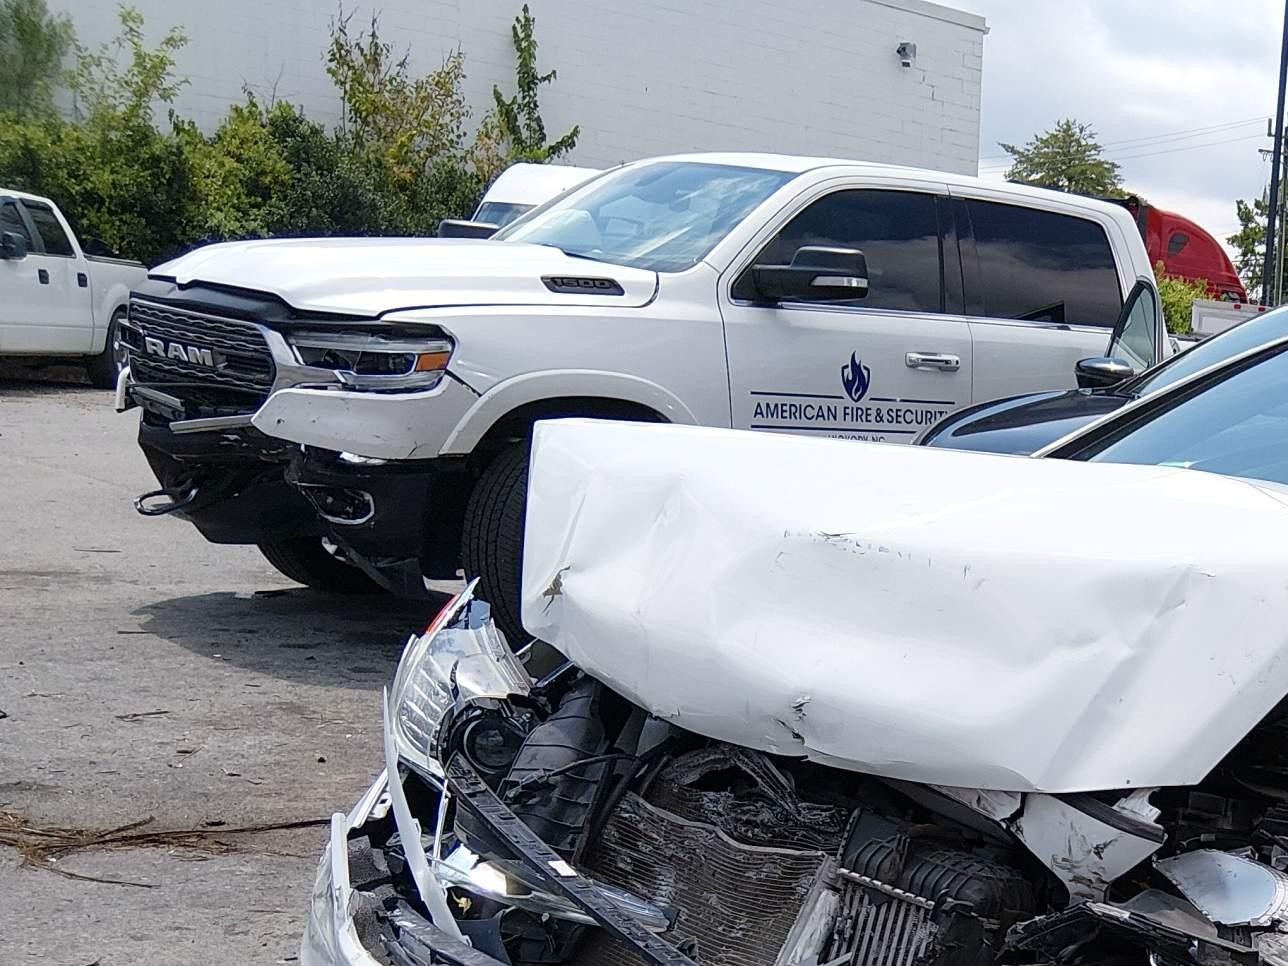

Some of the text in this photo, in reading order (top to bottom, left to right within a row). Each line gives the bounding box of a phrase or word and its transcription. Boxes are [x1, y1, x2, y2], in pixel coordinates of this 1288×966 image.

[553, 278, 611, 289] 1500
[144, 336, 214, 367] RAM
[753, 402, 949, 426] AMERICAN FIRE & SECURIT
